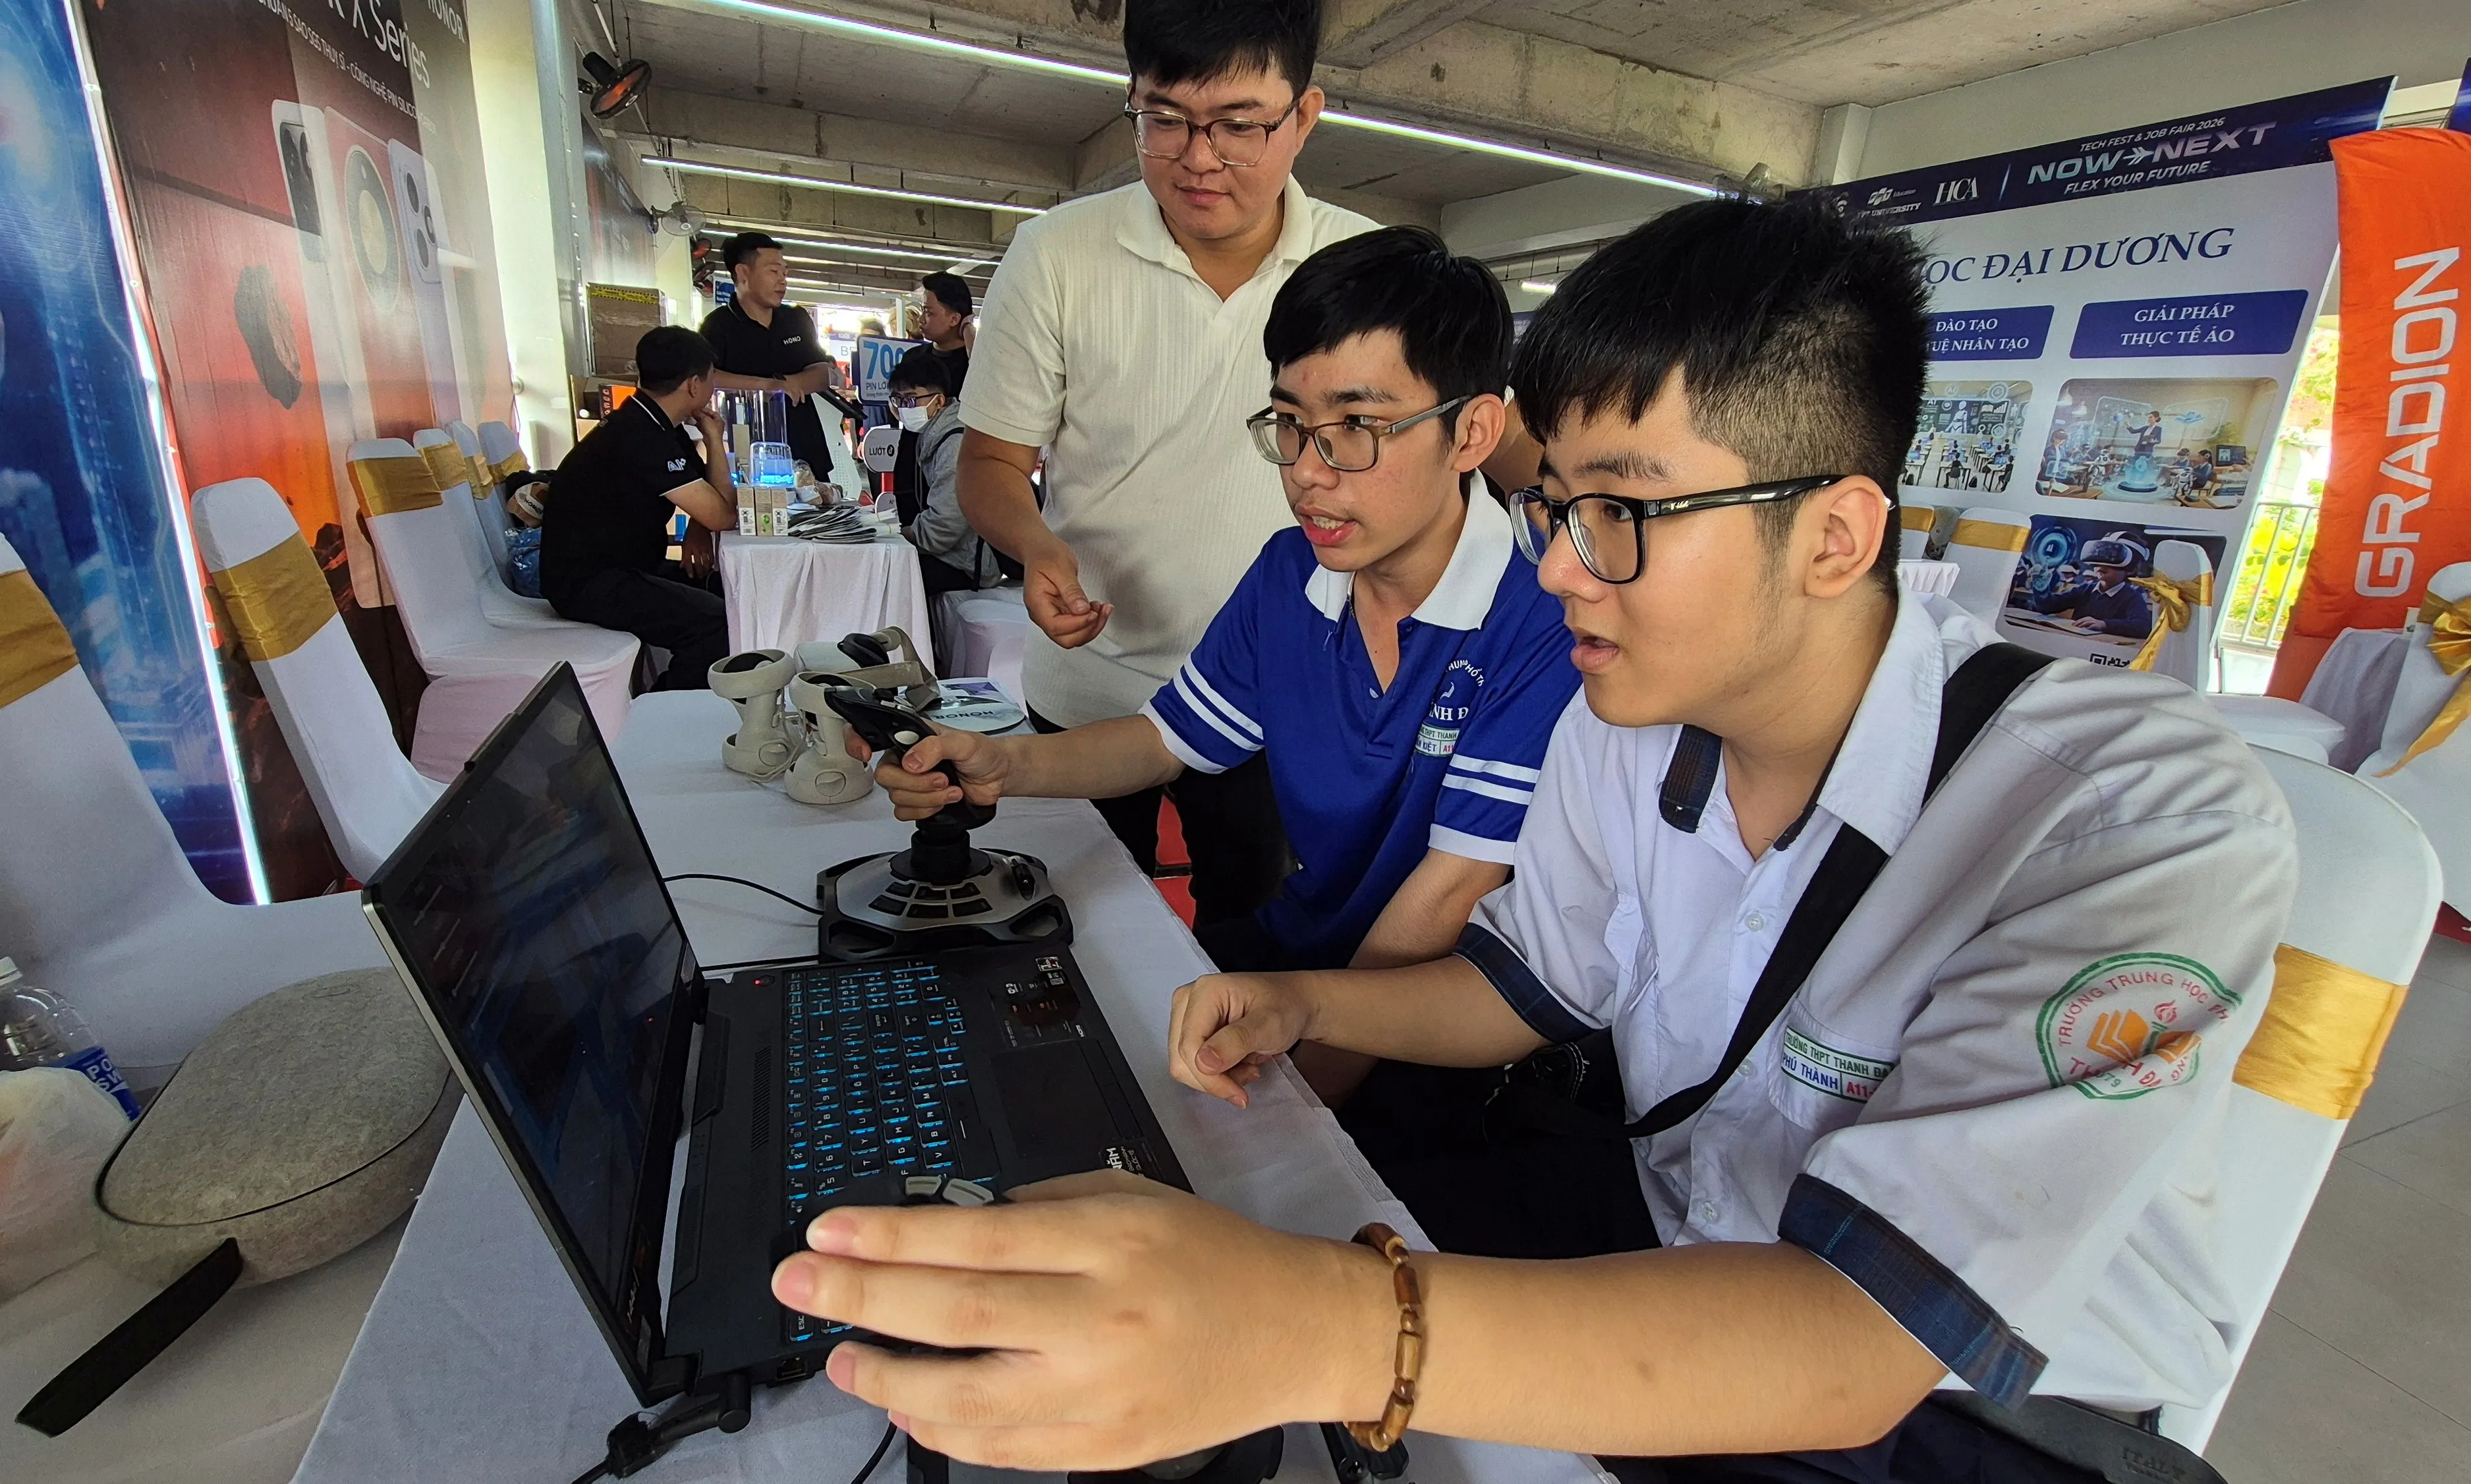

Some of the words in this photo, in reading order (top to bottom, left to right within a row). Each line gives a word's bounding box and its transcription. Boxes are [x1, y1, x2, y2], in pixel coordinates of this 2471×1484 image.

[293, 13, 308, 40] SAO
[369, 0, 430, 88] Series
[2080, 140, 2105, 152] TECH
[2108, 134, 2134, 147] FEST
[2144, 128, 2167, 140] JOB
[2169, 123, 2196, 136] FAIR
[2196, 117, 2226, 131] 2026
[2027, 150, 2125, 185] NOW
[2151, 121, 2277, 163] NEXT
[2063, 179, 2100, 195] FLEX
[2103, 171, 2144, 191] YOUR
[2147, 161, 2212, 181] FUTURE
[1867, 187, 1894, 206] FPT
[1871, 202, 1922, 217] UNIVERSITY
[1925, 257, 1975, 291] ỌC
[1981, 248, 2055, 284] ĐẠI
[2060, 228, 2235, 271] DƯƠNG
[2134, 304, 2178, 322] GIẢI
[2178, 302, 2235, 320] PHÁP
[1936, 319, 1966, 332] ĐÀO
[1969, 318, 1999, 333] TẠO
[2120, 331, 2174, 348] THỰC
[2177, 324, 2202, 343] TẾ
[2203, 326, 2235, 343] ẢO
[1951, 337, 1997, 351] NHÂN
[1999, 337, 2030, 352] TẠO
[866, 382, 876, 390] PIN
[2354, 246, 2460, 598] GRADION
[933, 710, 994, 720] HONOR
[1458, 706, 1469, 720] Đ
[2059, 986, 2105, 1046] TRƯỜNG
[2105, 971, 2174, 990] TRUNG
[2181, 978, 2208, 1004] HỌC
[2209, 1004, 2229, 1020] PH
[86, 1058, 113, 1080] PO
[1782, 1052, 1798, 1071] PHÚ
[1801, 1063, 1838, 1090] THÀNH
[1810, 1046, 1830, 1064] THPT
[1833, 1056, 1869, 1076] THANH
[1847, 1081, 1877, 1098] A11-
